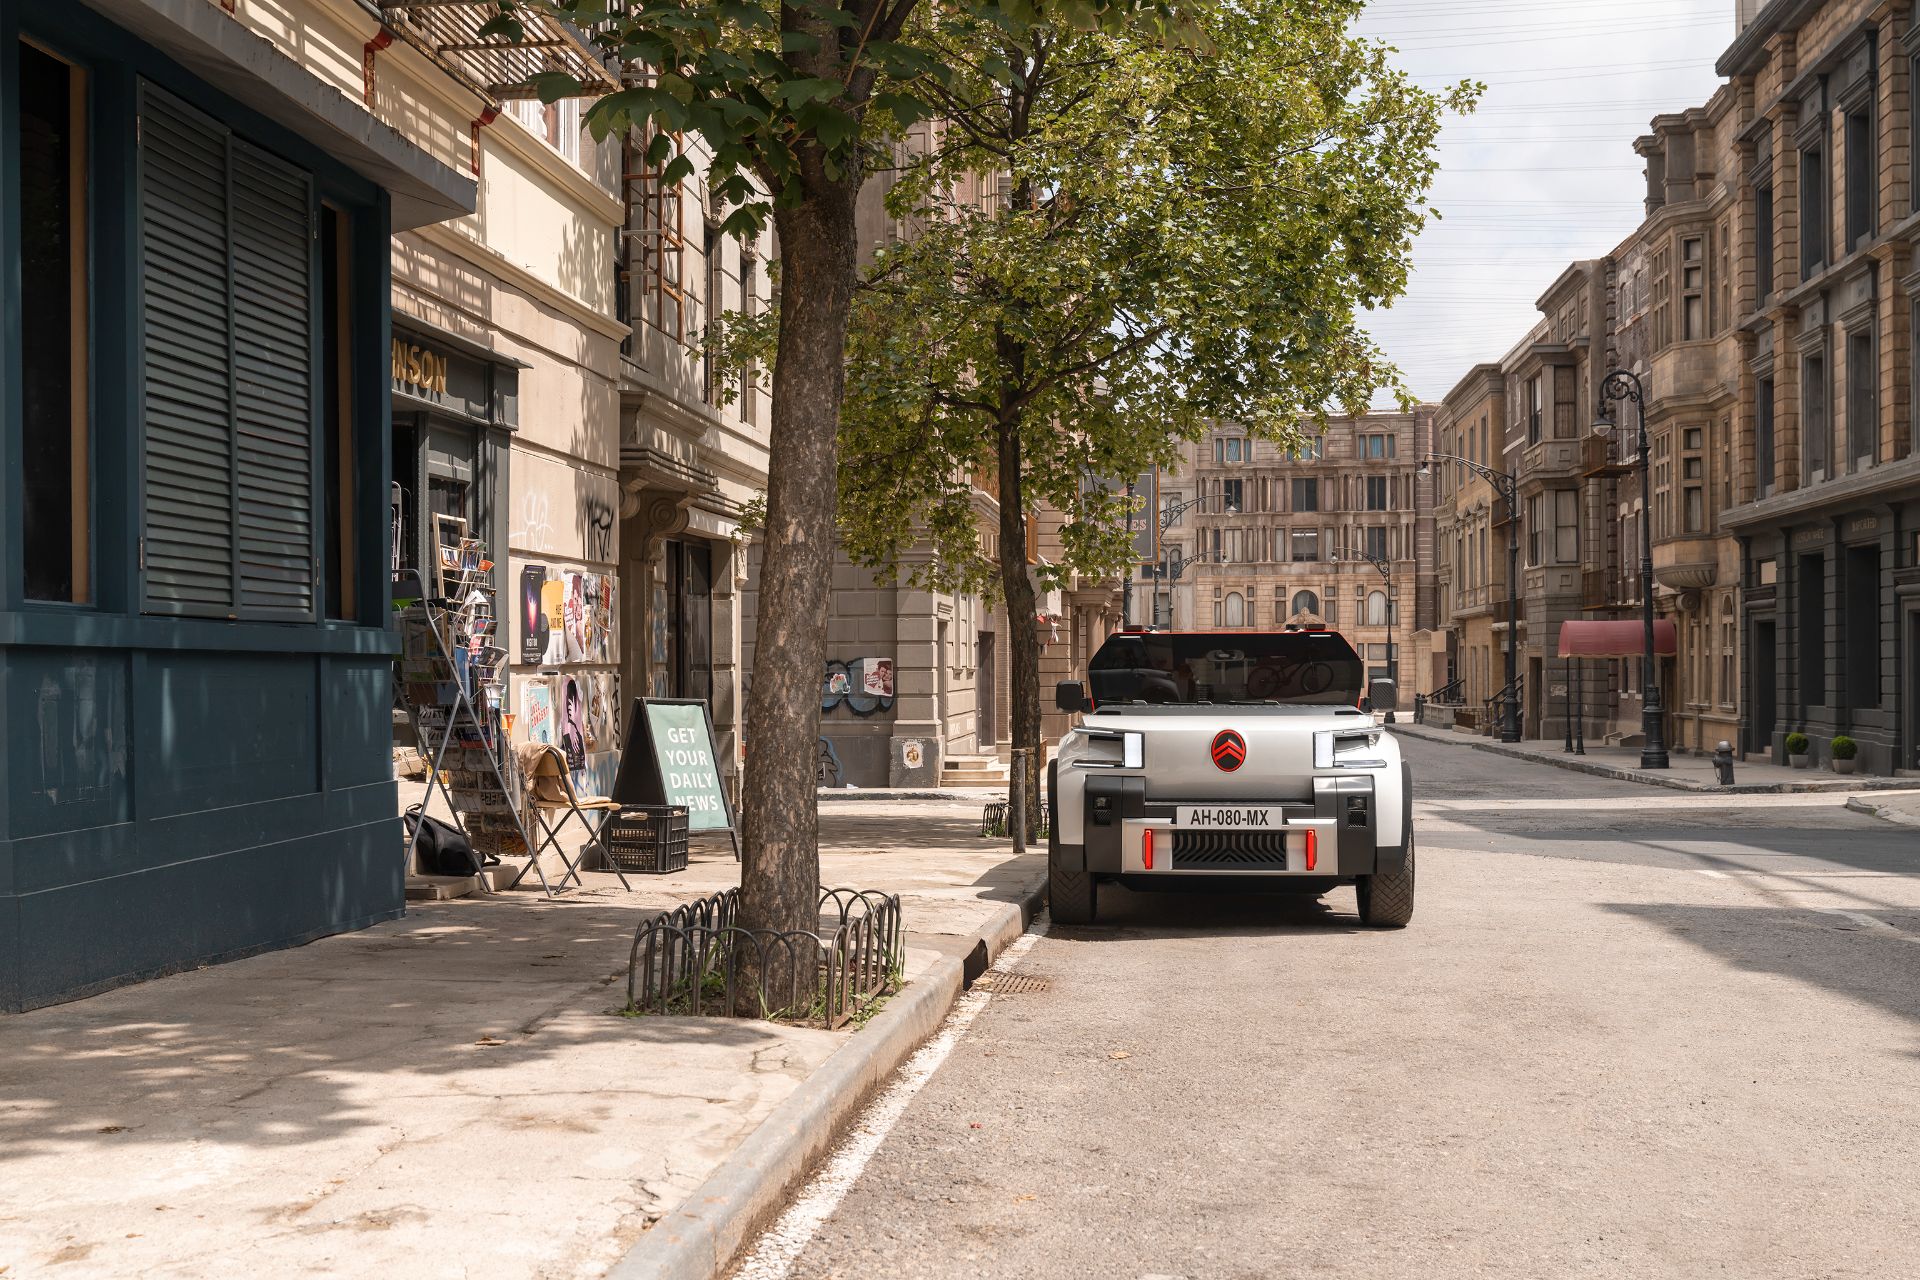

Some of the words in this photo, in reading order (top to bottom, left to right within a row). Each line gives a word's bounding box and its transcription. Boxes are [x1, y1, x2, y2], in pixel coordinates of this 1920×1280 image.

[392, 338, 446, 393] NSON
[667, 727, 696, 744] GET
[665, 750, 709, 766] YOUR
[669, 772, 712, 789] DAILY
[675, 795, 719, 812] NEWS
[1190, 809, 1269, 826] AH-080-MX
